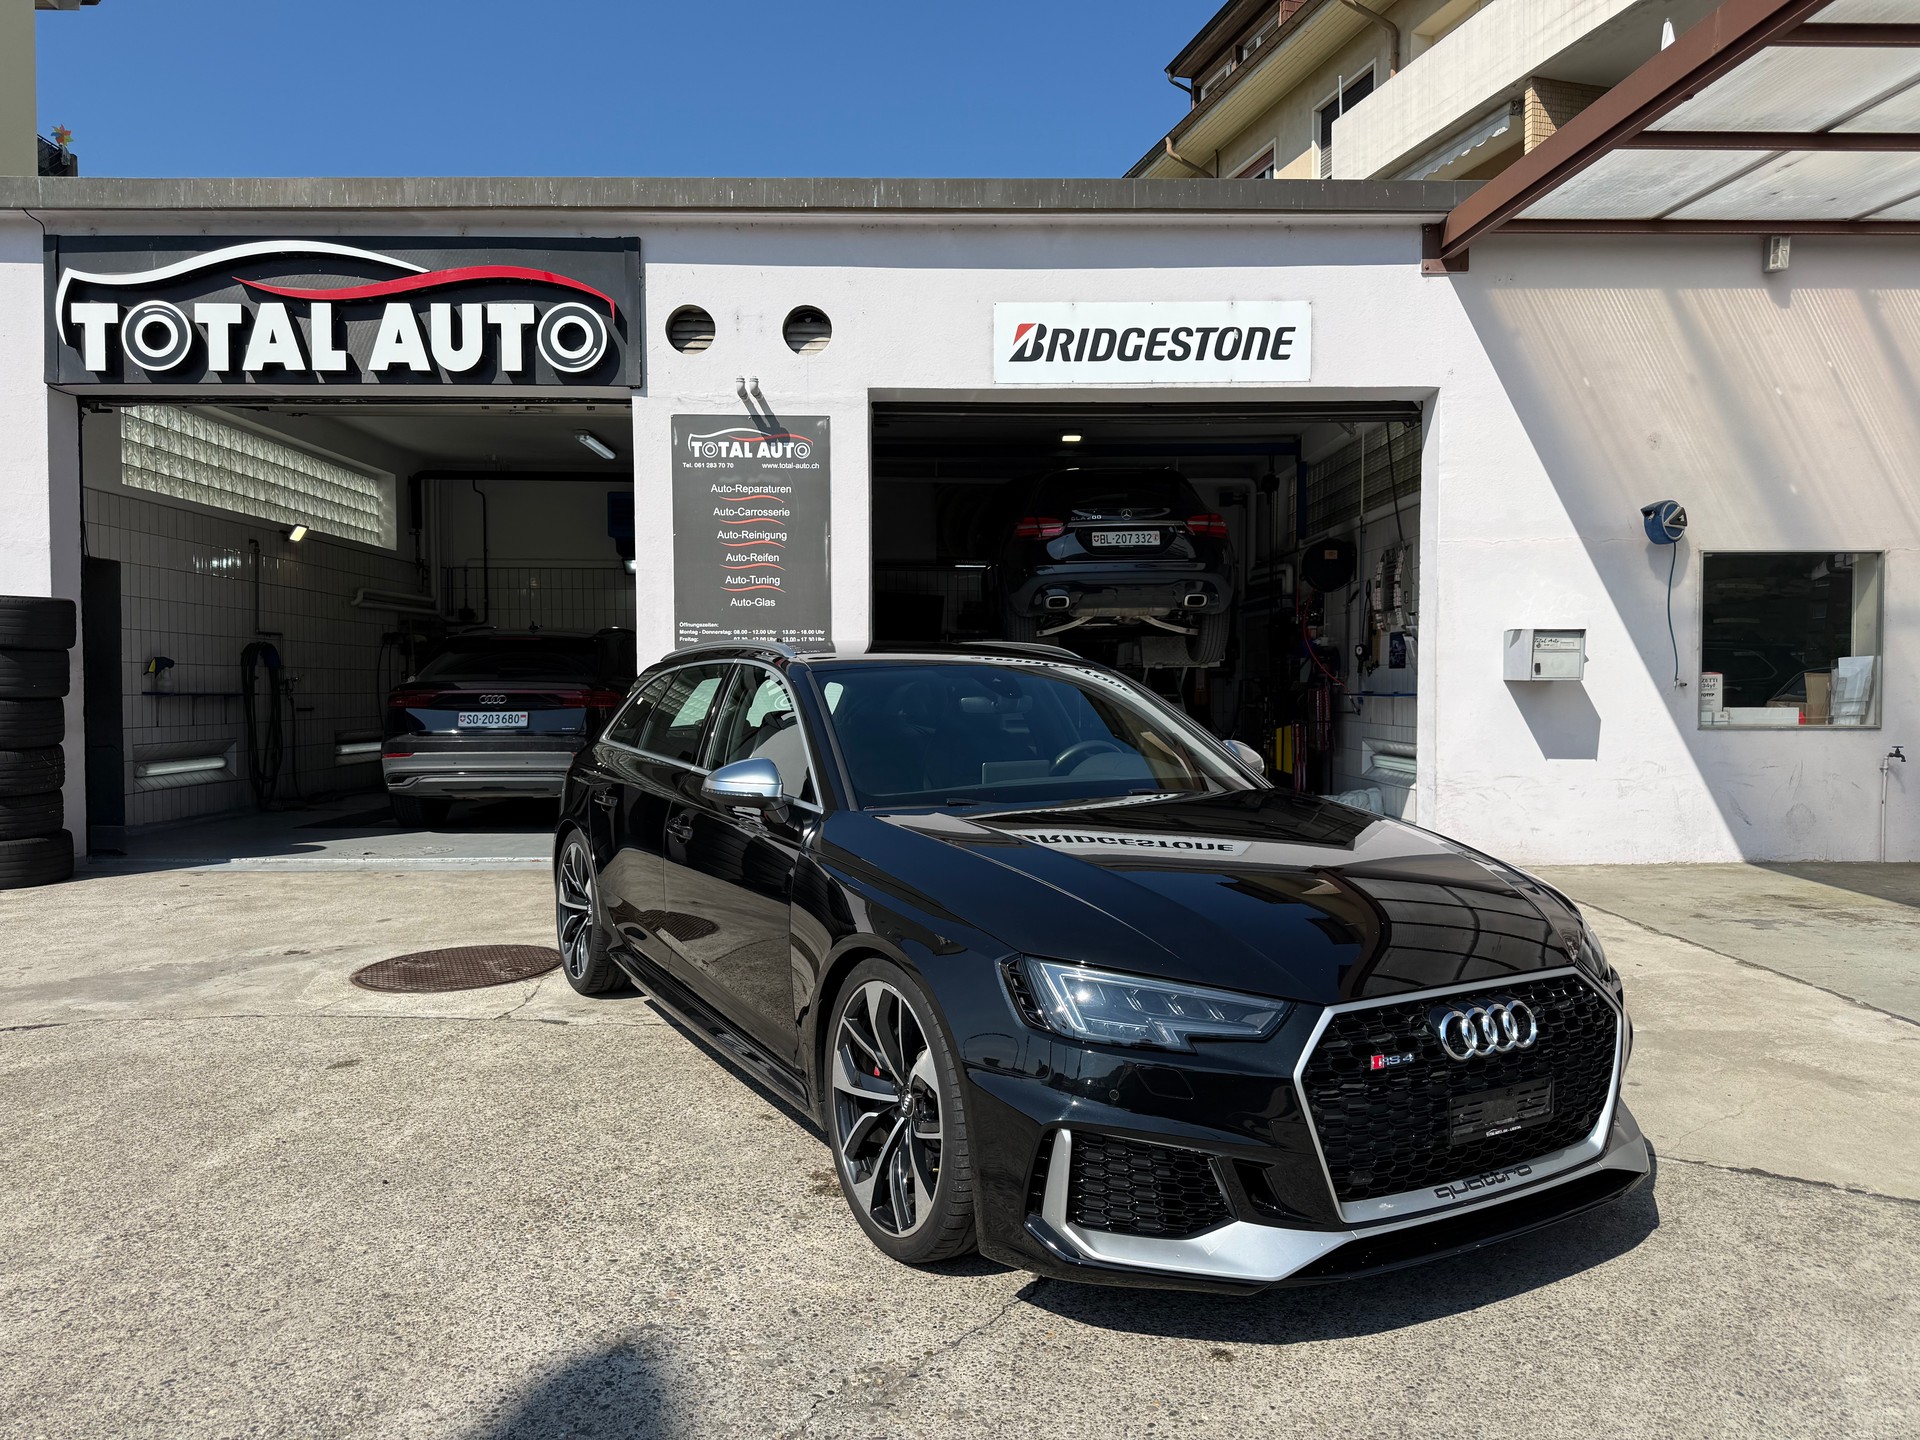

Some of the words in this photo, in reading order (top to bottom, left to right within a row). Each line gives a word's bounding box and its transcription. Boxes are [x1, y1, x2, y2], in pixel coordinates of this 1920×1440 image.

[71, 300, 347, 372] TOTAL
[367, 301, 608, 373] AUTO
[1008, 323, 1296, 362] BRIDGESTONE
[691, 441, 753, 458] TOTAL
[757, 442, 811, 459] AUTO
[710, 484, 792, 495] Auto-Reparaturen
[713, 507, 790, 517] Auto-Carrosserie
[717, 530, 787, 543] Auto-Reinigung
[725, 553, 779, 563] Auto-Reifen
[725, 575, 780, 587] Auto-Tuning
[730, 598, 776, 607] Auto-Glas
[1433, 1164, 1532, 1199] quattro
